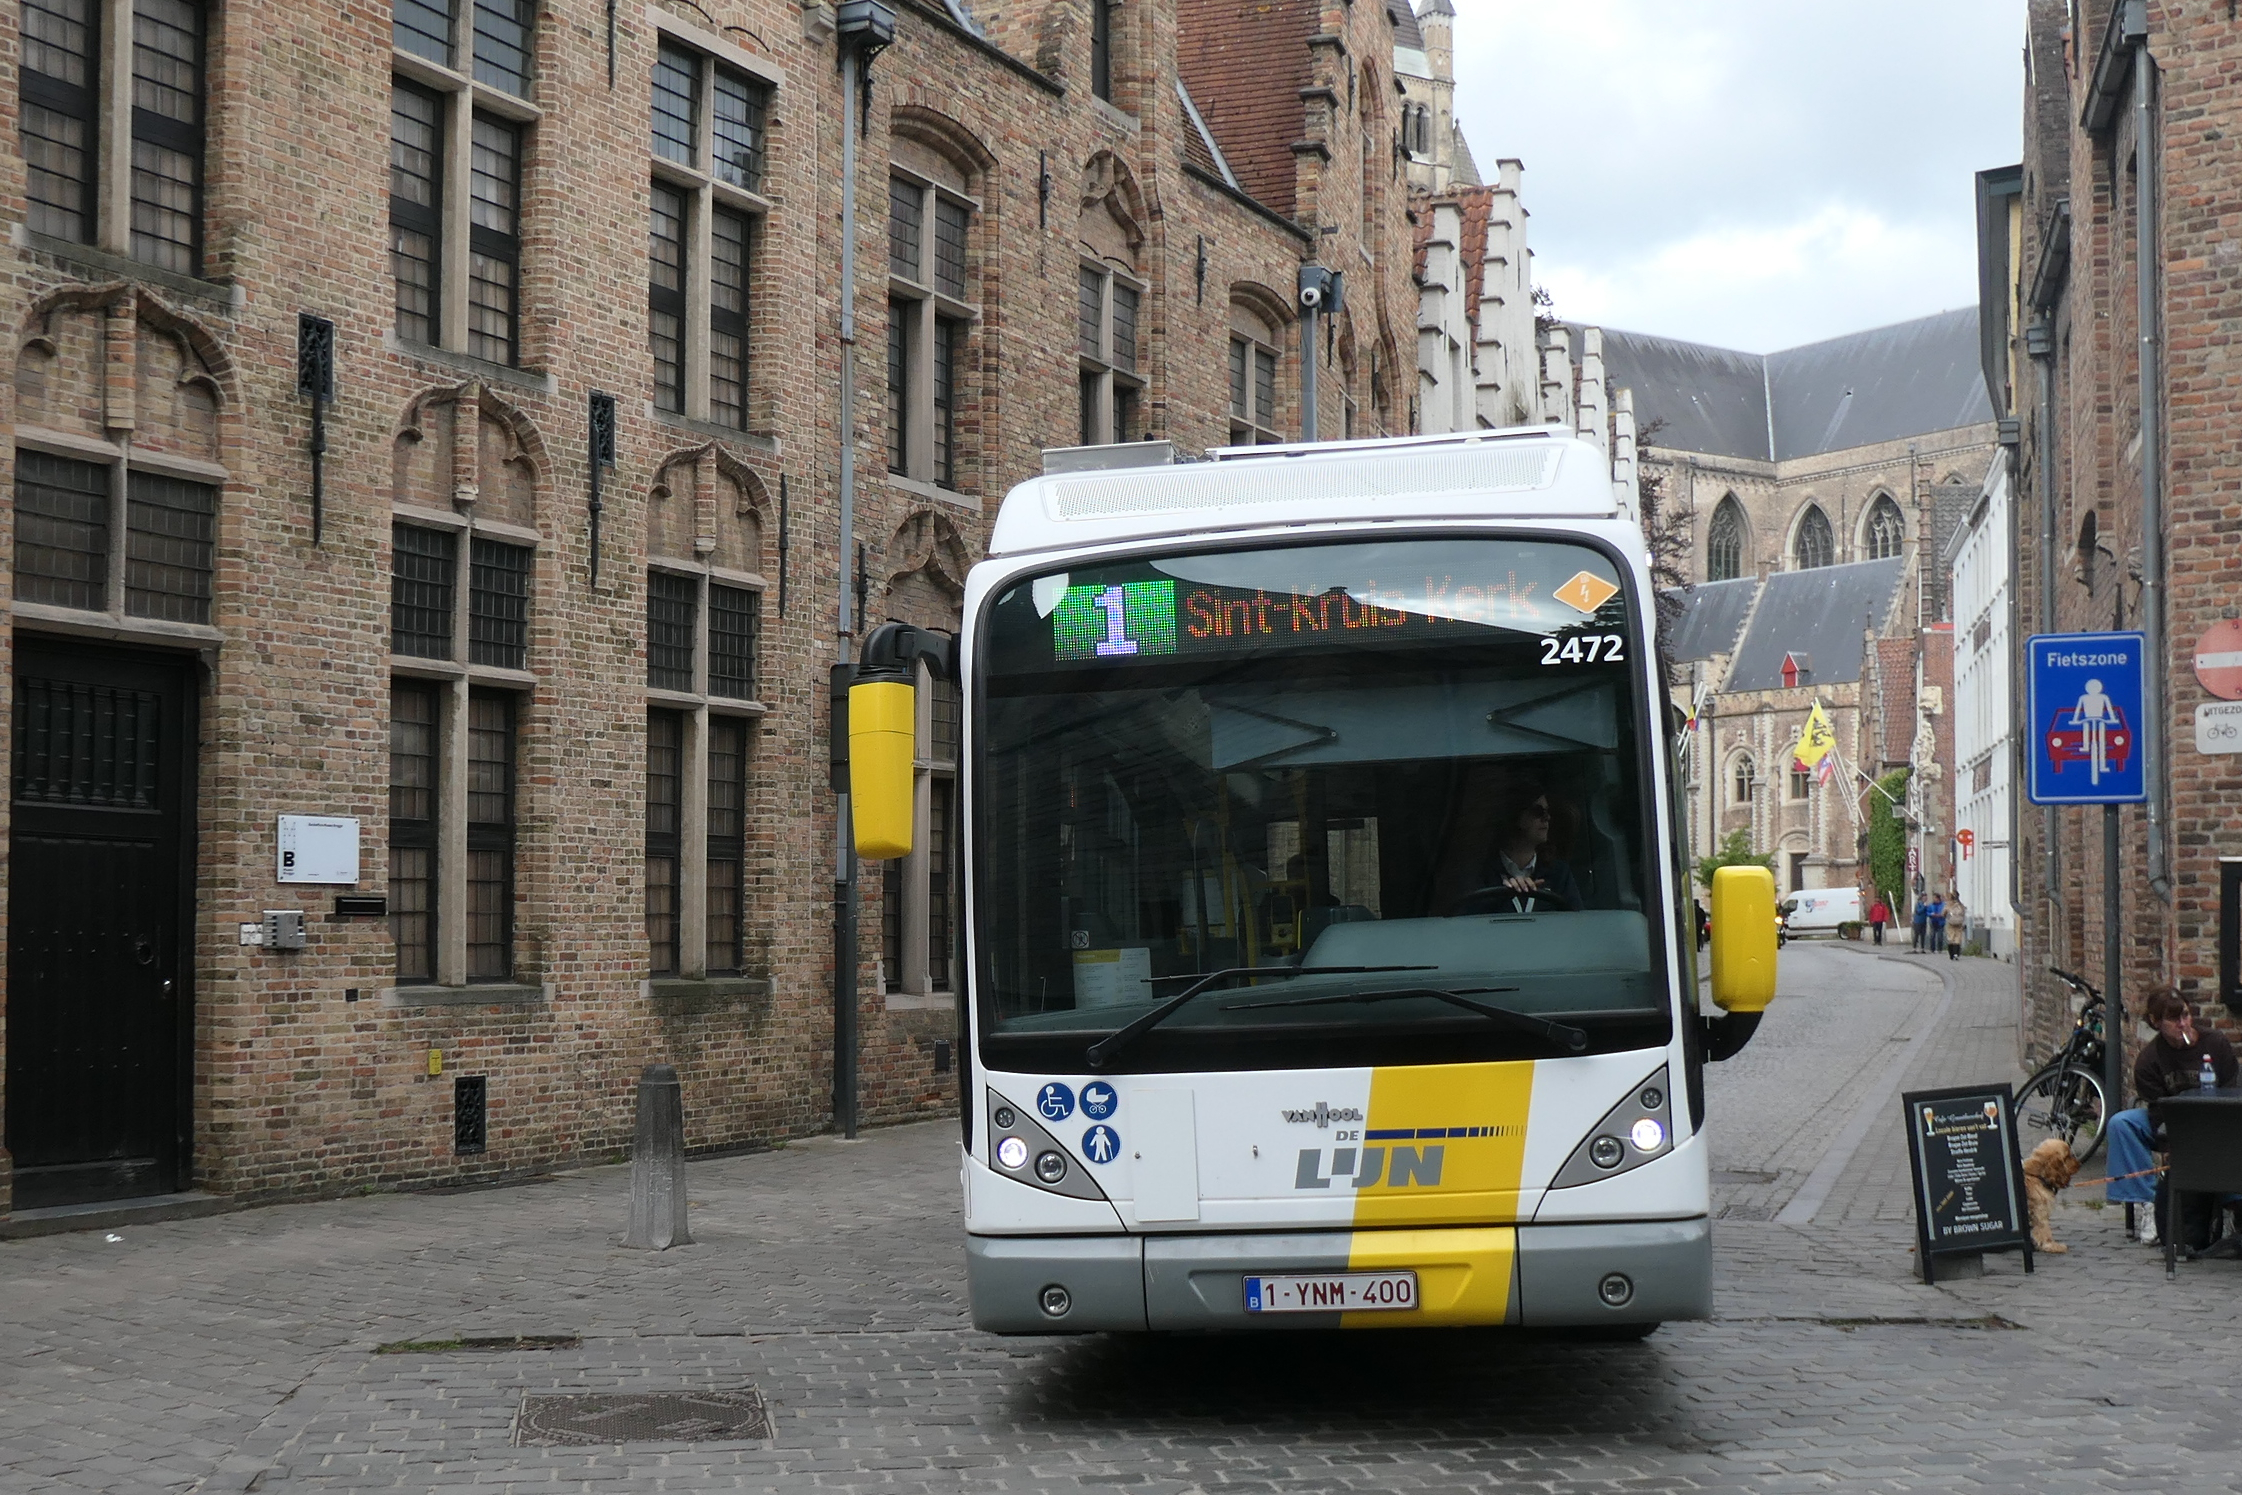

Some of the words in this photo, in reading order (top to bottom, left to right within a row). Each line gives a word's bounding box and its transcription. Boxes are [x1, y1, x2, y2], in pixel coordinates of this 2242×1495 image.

[1094, 586, 1138, 656] 1
[1186, 579, 1407, 638] Sint-Kruis
[1426, 570, 1540, 624] Kerk
[1540, 634, 1624, 665] 2472
[2047, 652, 2128, 667] Fietszone
[283, 850, 295, 868] B
[1335, 1130, 1359, 1142] DE
[1295, 1145, 1445, 1189] LIJN
[1942, 1226, 1952, 1236] BY
[1953, 1223, 1979, 1235] BROWN
[1980, 1220, 2003, 1231] SUGAR
[1250, 1296, 1259, 1308] B
[1265, 1279, 1411, 1306] 1-YNM-400
